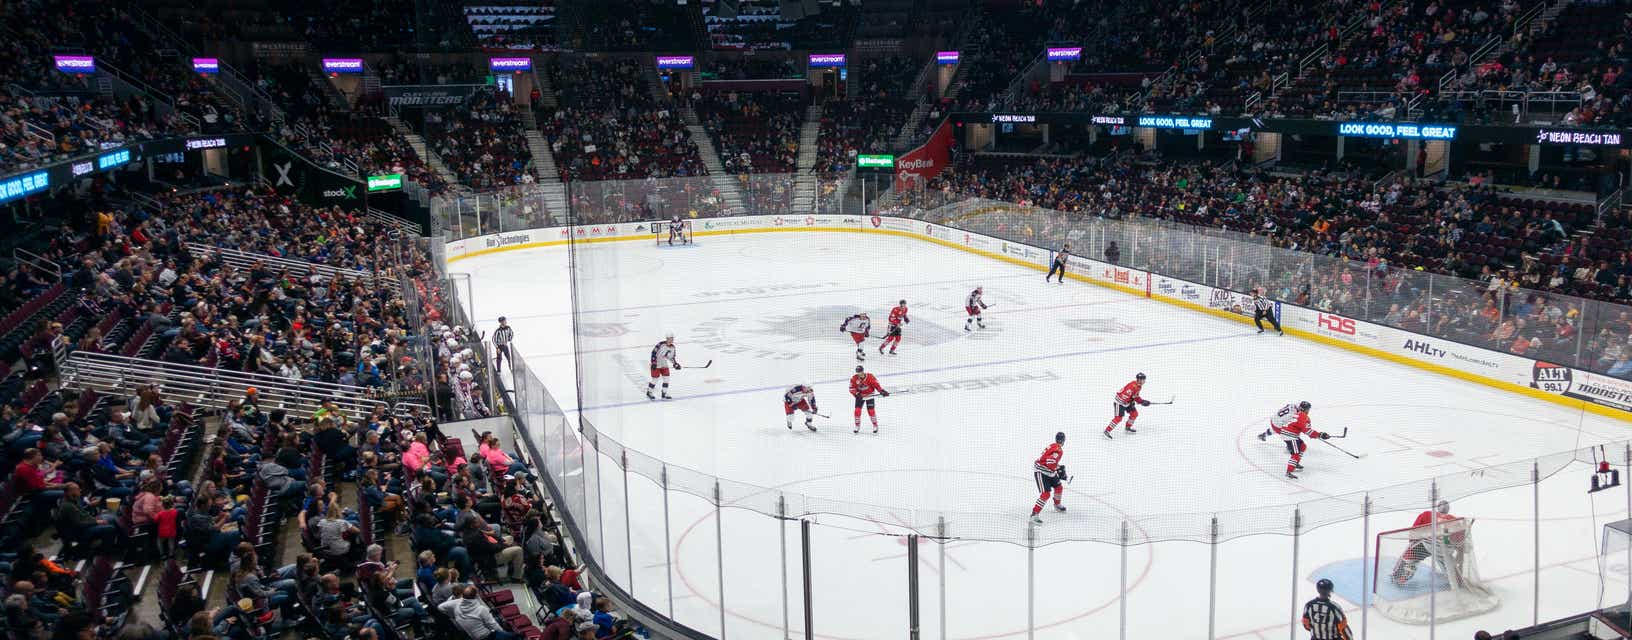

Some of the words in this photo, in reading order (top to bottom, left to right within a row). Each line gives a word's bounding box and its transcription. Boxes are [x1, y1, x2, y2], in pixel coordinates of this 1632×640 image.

[1140, 118, 1155, 126] LOOK
[1156, 118, 1175, 128] GOOD,
[1175, 119, 1190, 127] FEEL
[1191, 120, 1212, 128] GREAT
[1340, 123, 1365, 134] LOOK
[1365, 125, 1395, 137] GOOD,
[1396, 126, 1420, 137] FEEL
[1421, 127, 1456, 138] GREAT
[1549, 131, 1571, 143] NEON
[1573, 132, 1601, 144] BEACH
[1603, 134, 1621, 145] TAN
[898, 159, 934, 170] KeyBank
[323, 185, 357, 199] stockX
[1319, 313, 1356, 335] HDS
[1538, 367, 1567, 380] ALT
[1543, 382, 1562, 392] 99.1
[1313, 611, 1327, 623] 47
